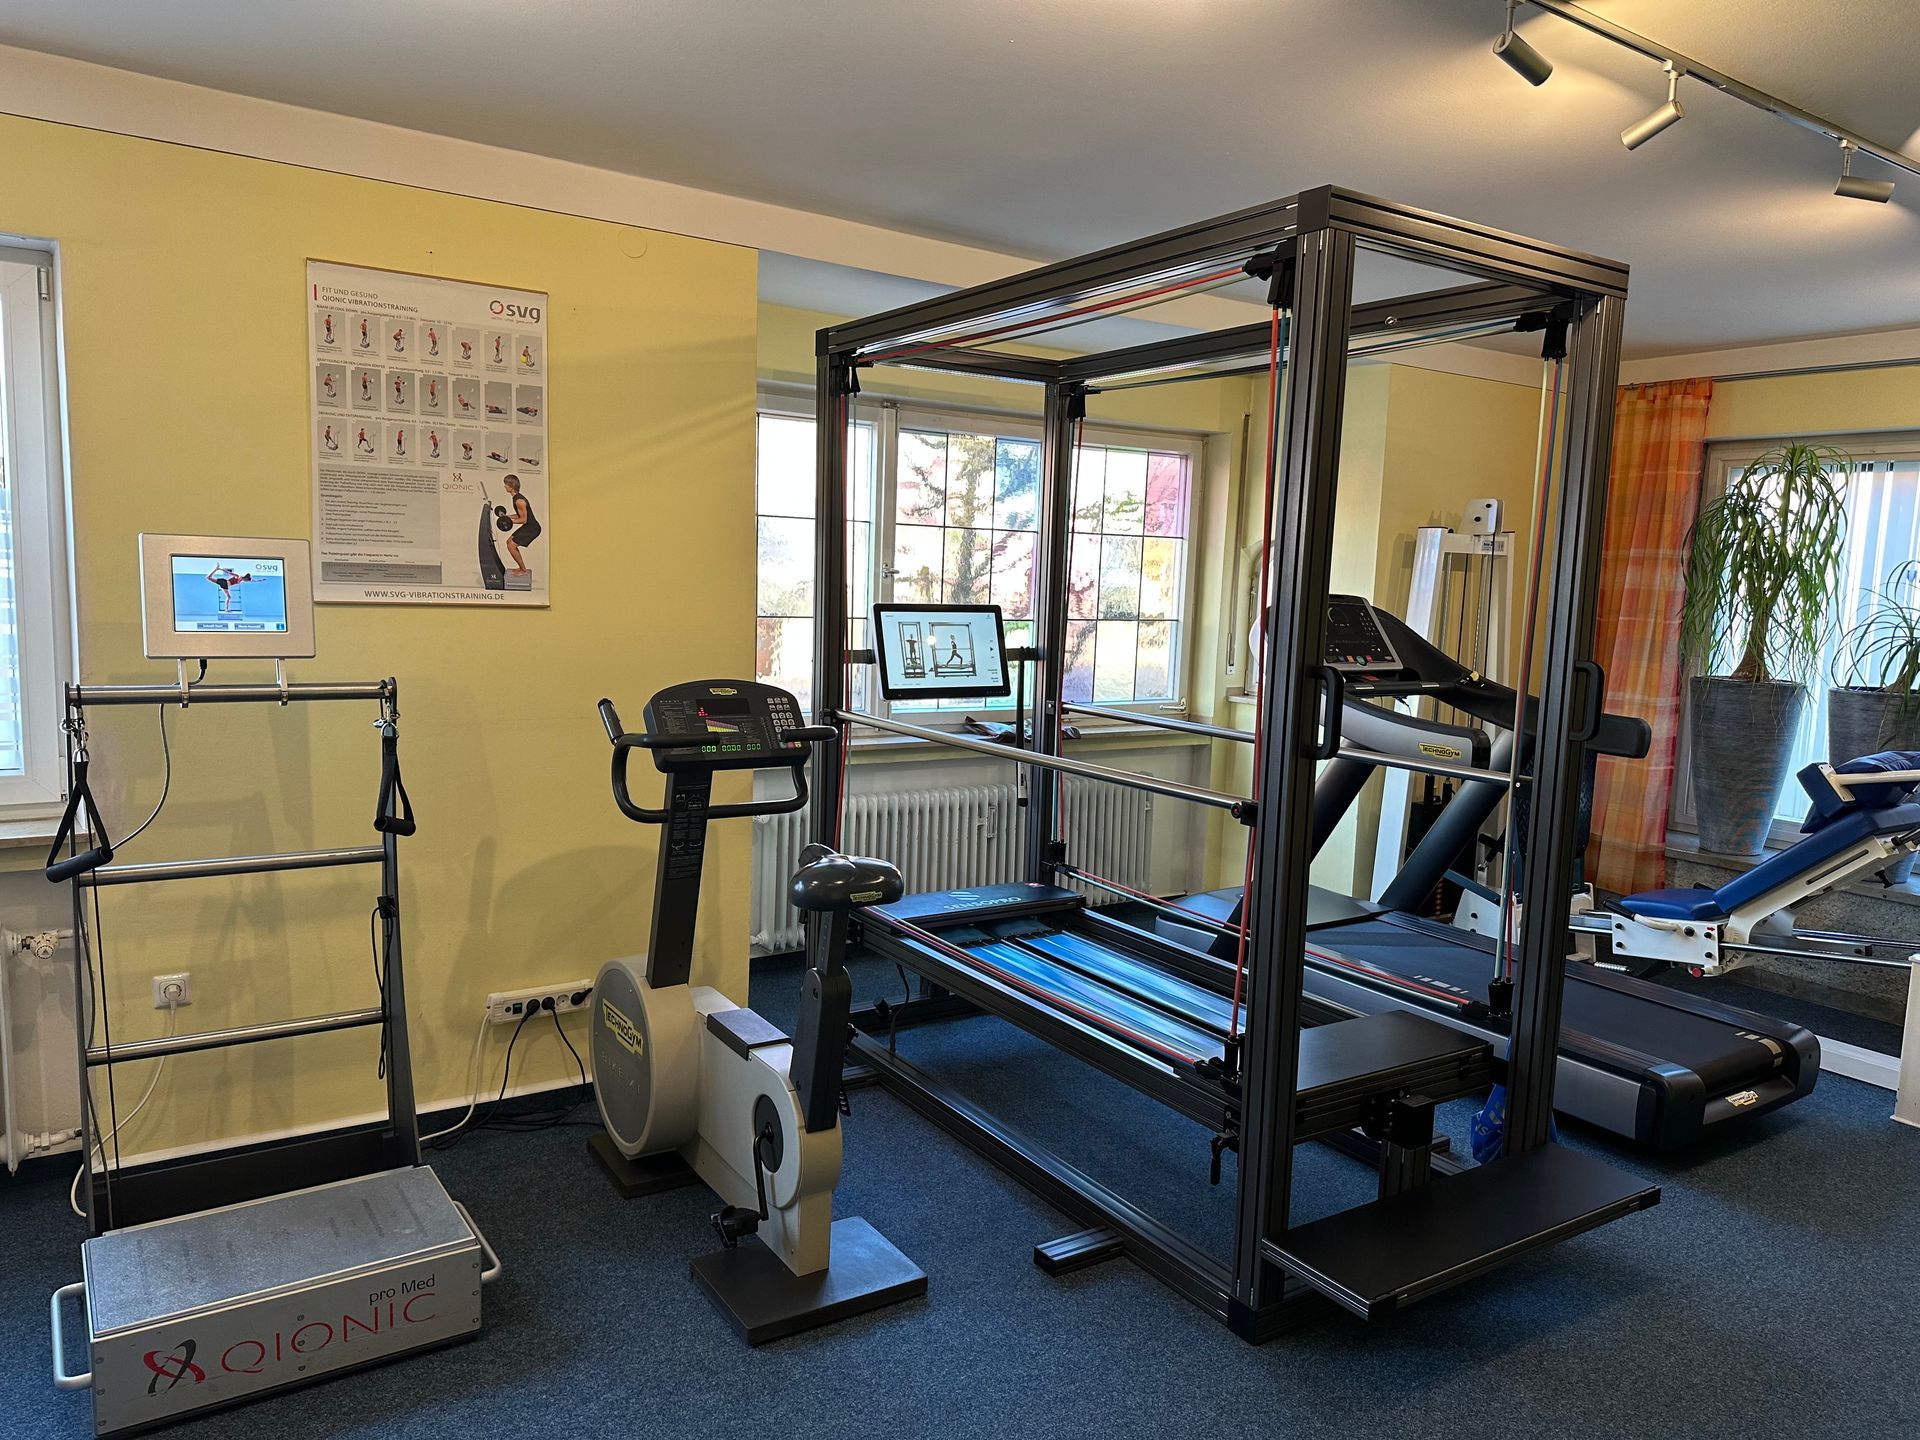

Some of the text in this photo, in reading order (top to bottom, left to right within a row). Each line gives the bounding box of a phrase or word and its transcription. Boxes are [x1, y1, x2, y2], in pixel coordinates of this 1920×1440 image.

[350, 290, 379, 300] GESUND
[322, 294, 418, 313] QIONIC VIBRATIONSTRAINING
[506, 304, 541, 324] svg
[442, 483, 474, 491] QIONIC
[364, 589, 505, 600] WWW.SVG-VIBRATIONSTRAINING.DE
[1420, 744, 1460, 757] TECHNOGYM
[944, 896, 1022, 909] SENSOPRO
[603, 1002, 642, 1049] TECHNOGYM
[368, 1274, 436, 1306] pro Med
[221, 1292, 436, 1374] QIONIC
